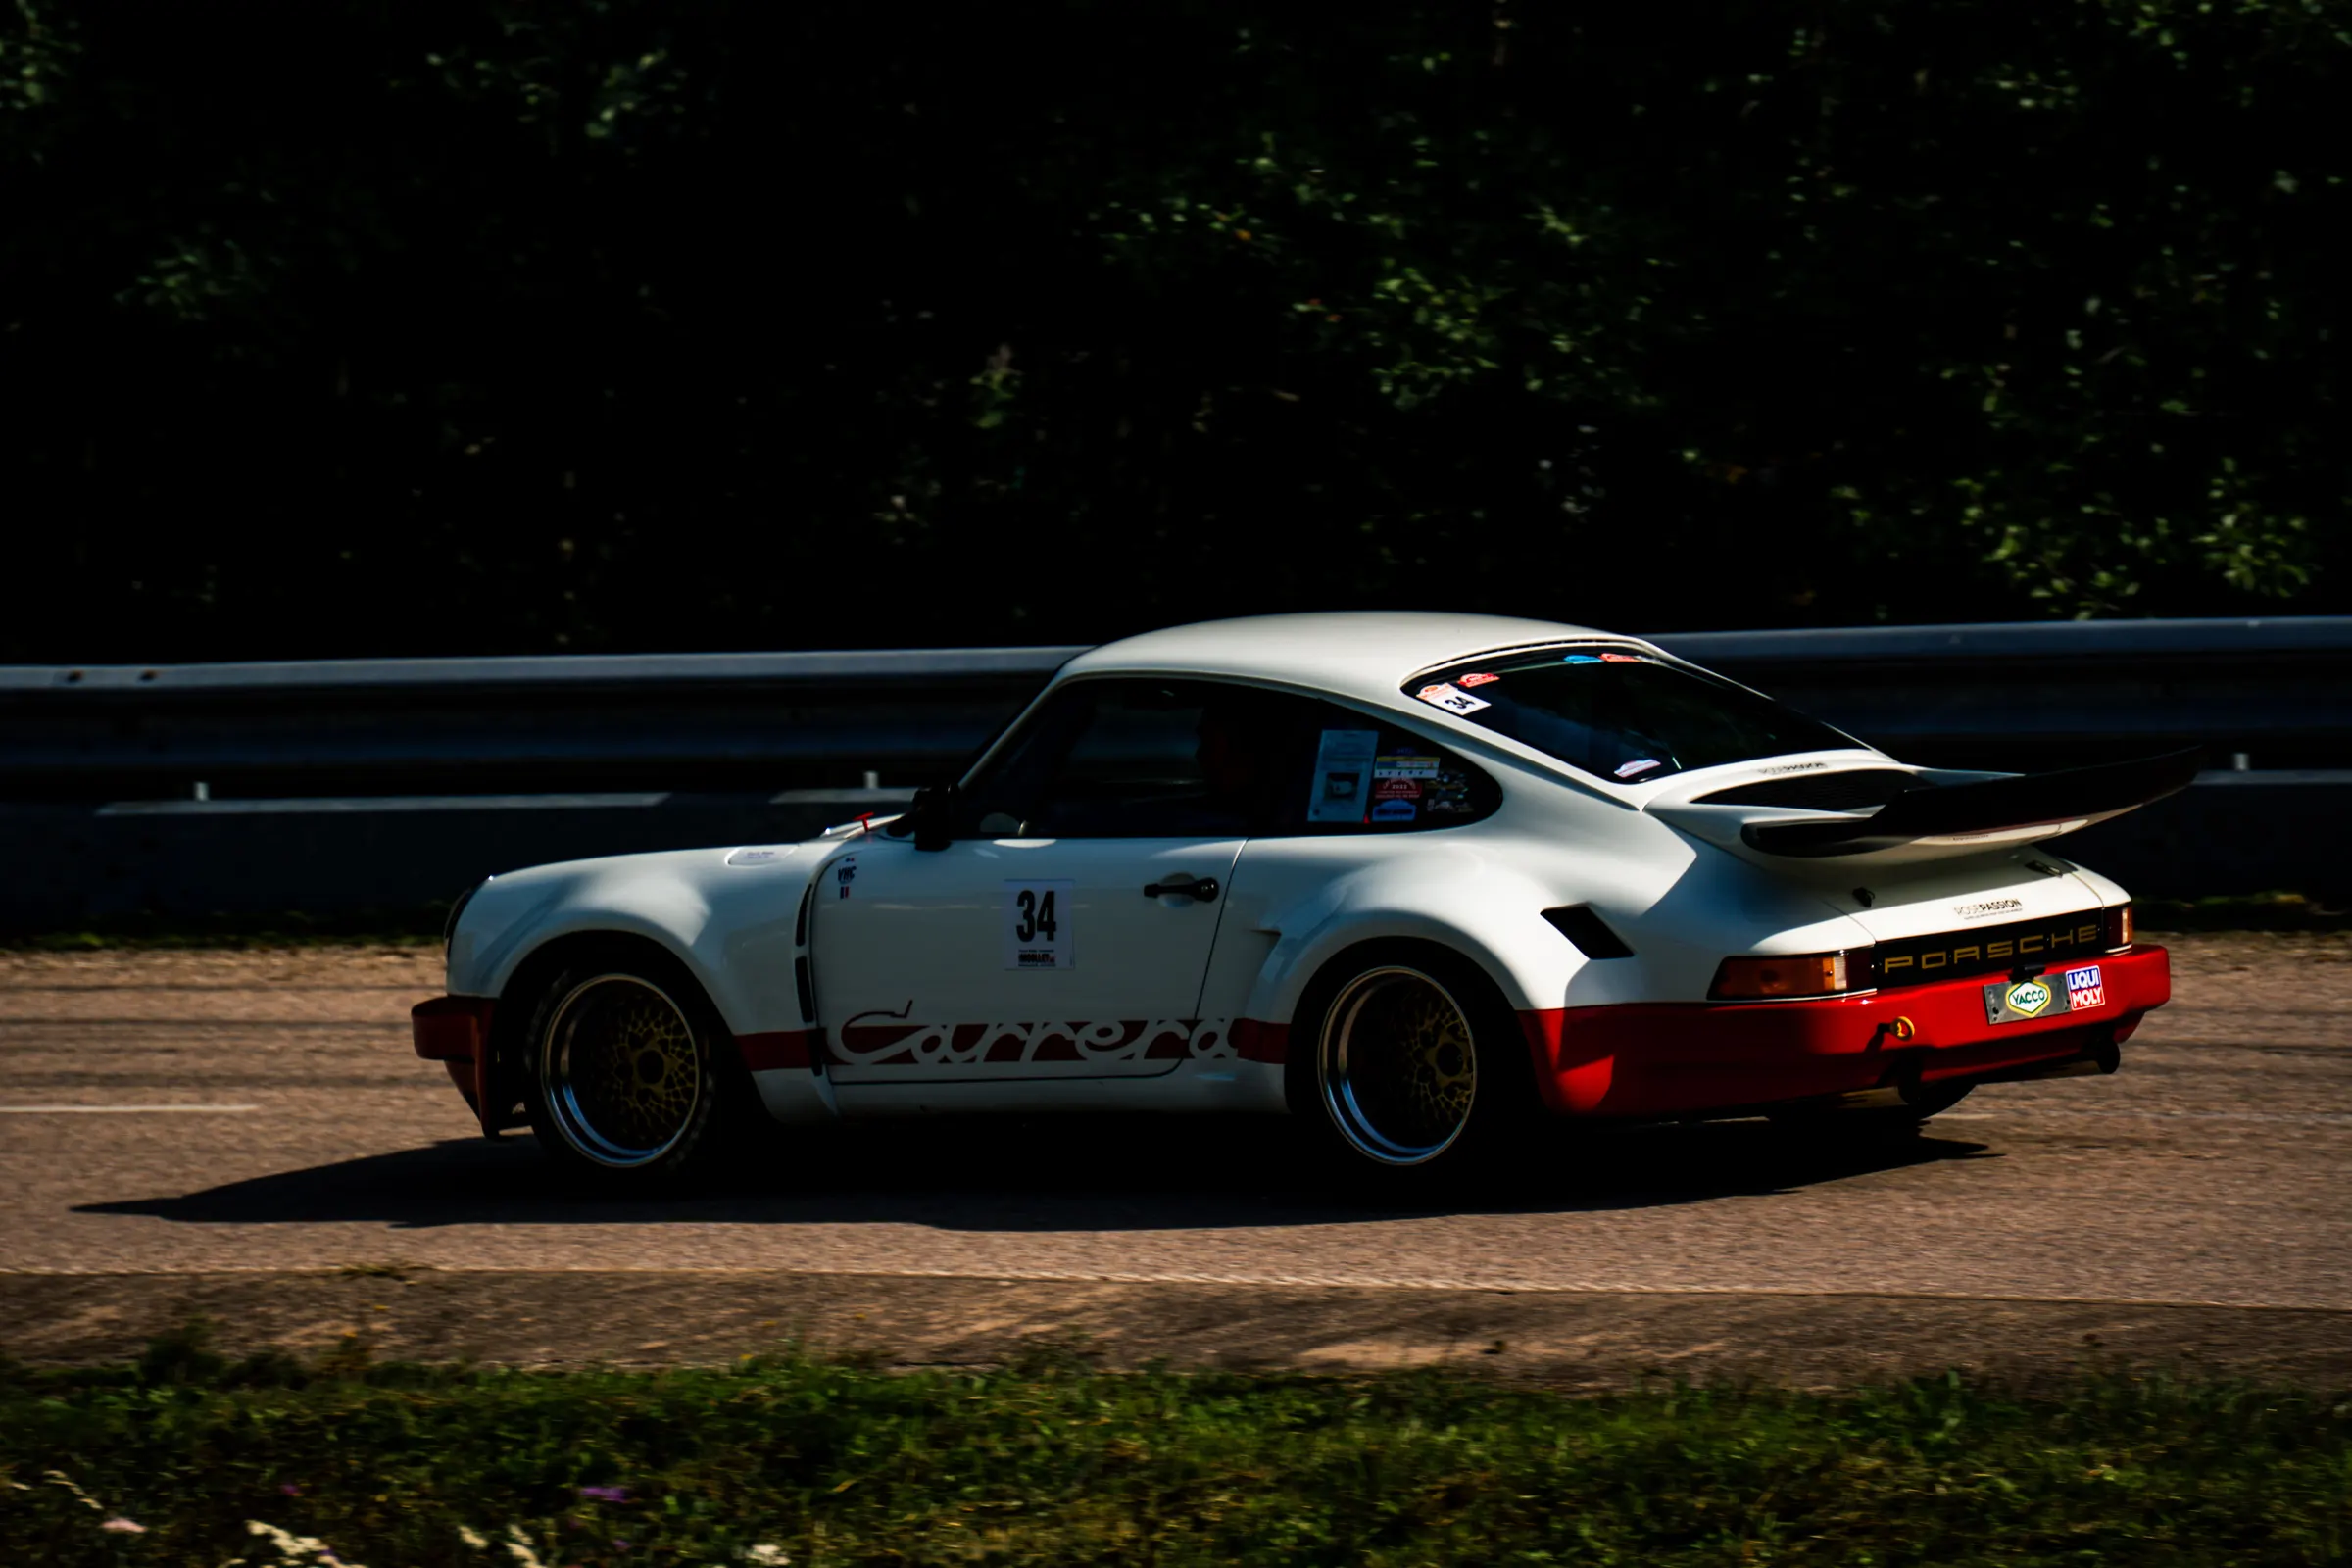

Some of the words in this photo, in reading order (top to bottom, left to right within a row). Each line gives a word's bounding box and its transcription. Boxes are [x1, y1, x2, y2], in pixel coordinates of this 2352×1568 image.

[1444, 695, 1476, 710] 34
[1016, 890, 1056, 942] 34
[1884, 924, 2098, 974] PORSCHE
[2068, 968, 2099, 991] LIQUI
[2012, 989, 2045, 1004] YACCO
[2071, 987, 2102, 1008] MOLY
[825, 1000, 1239, 1066] Carrera
